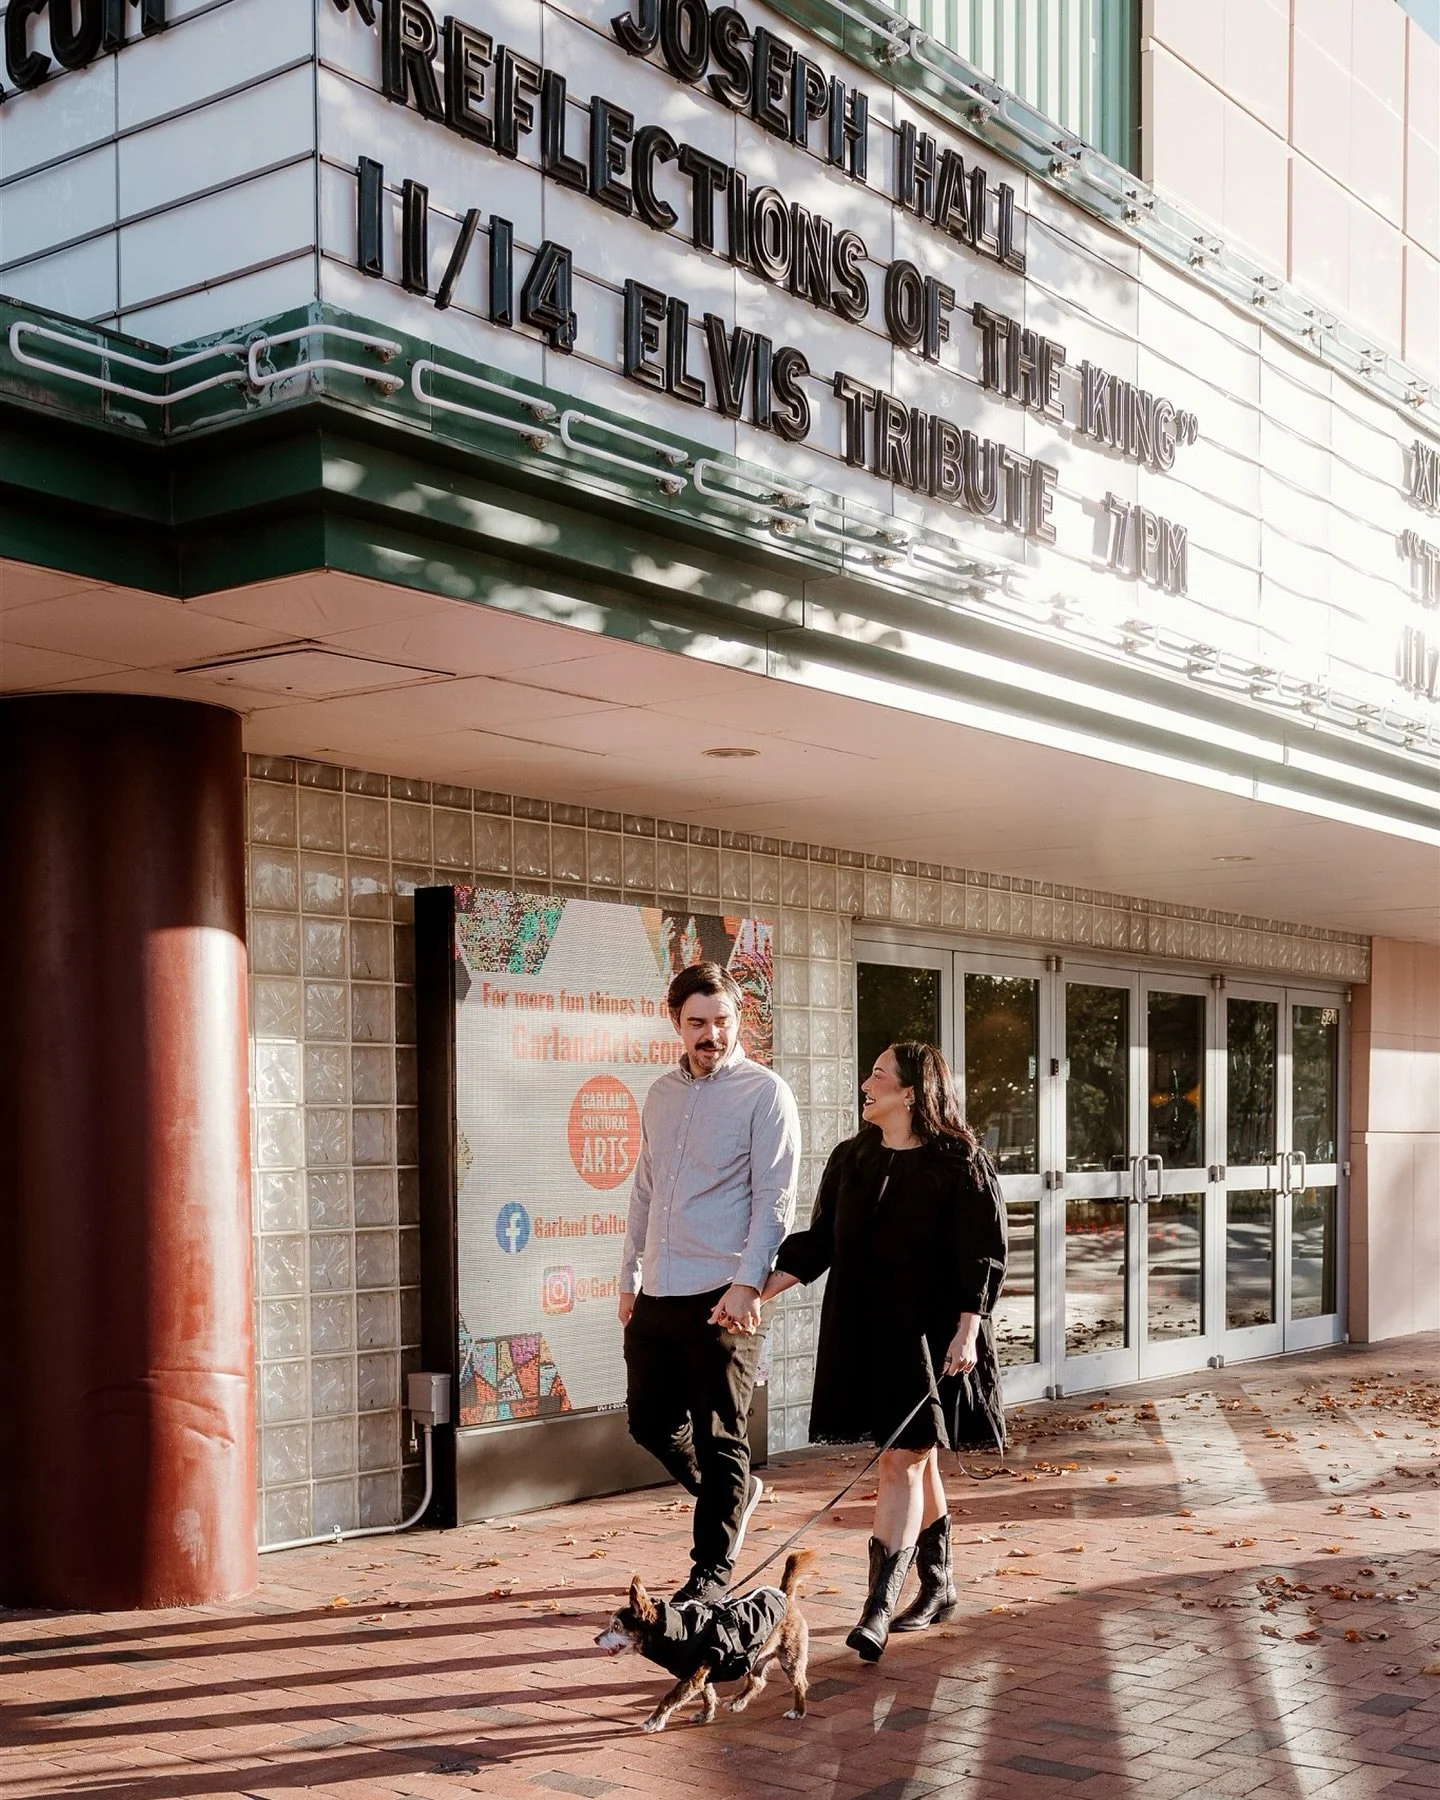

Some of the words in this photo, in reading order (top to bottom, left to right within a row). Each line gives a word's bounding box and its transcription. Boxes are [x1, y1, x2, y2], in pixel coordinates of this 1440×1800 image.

[611, 0, 868, 184] JOSEPH
[900, 118, 1026, 275] HALL
[885, 260, 955, 364] OF
[973, 302, 1067, 423] THE
[358, 156, 578, 356] 11/14
[623, 278, 810, 442] ELVIS
[834, 370, 1058, 546] TRIBUTE
[1104, 491, 1188, 596] 7PM
[481, 982, 508, 1009] For
[514, 989, 554, 1012] more
[560, 985, 584, 1012] fun
[589, 991, 634, 1020] things
[640, 994, 655, 1017] to
[581, 1092, 629, 1109] GARLAND
[581, 1114, 628, 1131] CULTURAL
[581, 1135, 630, 1174] ARTS
[534, 1215, 586, 1239] Garland
[592, 1213, 626, 1235] Cultu
[575, 1275, 621, 1302] @Garl
